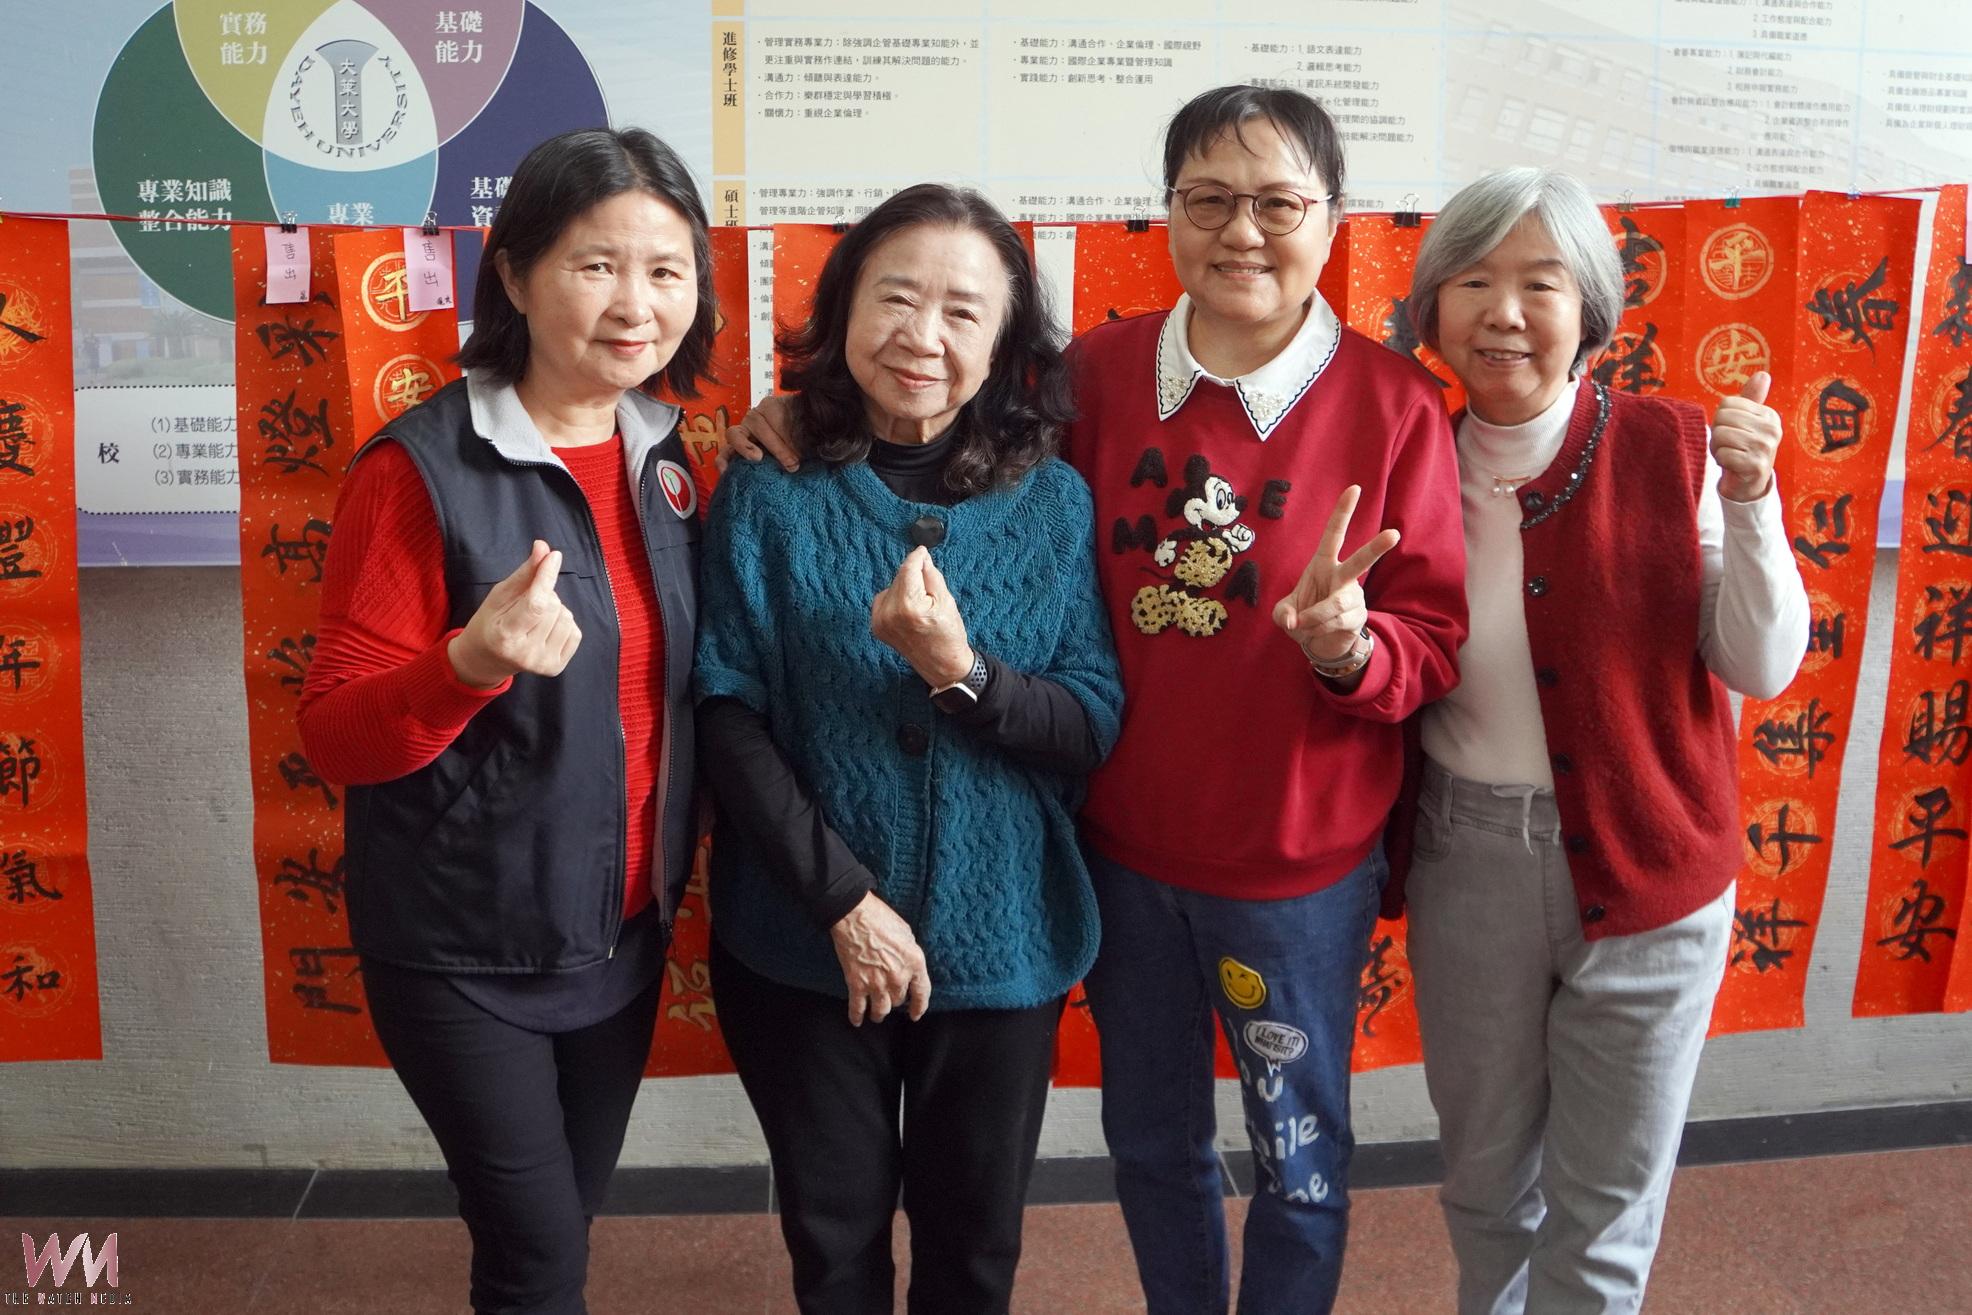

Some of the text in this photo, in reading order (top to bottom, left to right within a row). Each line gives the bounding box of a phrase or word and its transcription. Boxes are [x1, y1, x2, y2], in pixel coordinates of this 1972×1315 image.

[220, 12, 267, 36] 實務
[435, 11, 483, 34] 基礎
[220, 41, 268, 65] 能力
[435, 40, 483, 64] 能力
[722, 31, 738, 107] 進修學士班
[316, 56, 409, 158] UNIVERSITY
[339, 57, 360, 140] 大葉大學
[138, 178, 232, 204] 專業知識
[138, 207, 232, 233] 整合能力
[328, 202, 374, 226] 專業
[471, 205, 501, 227] 資
[1704, 230, 1771, 387] 平安
[98, 442, 120, 464] 校
[1130, 447, 1168, 488] A
[1258, 478, 1292, 520] E
[1112, 514, 1157, 555] M
[1262, 1028, 1286, 1045] LOVE
